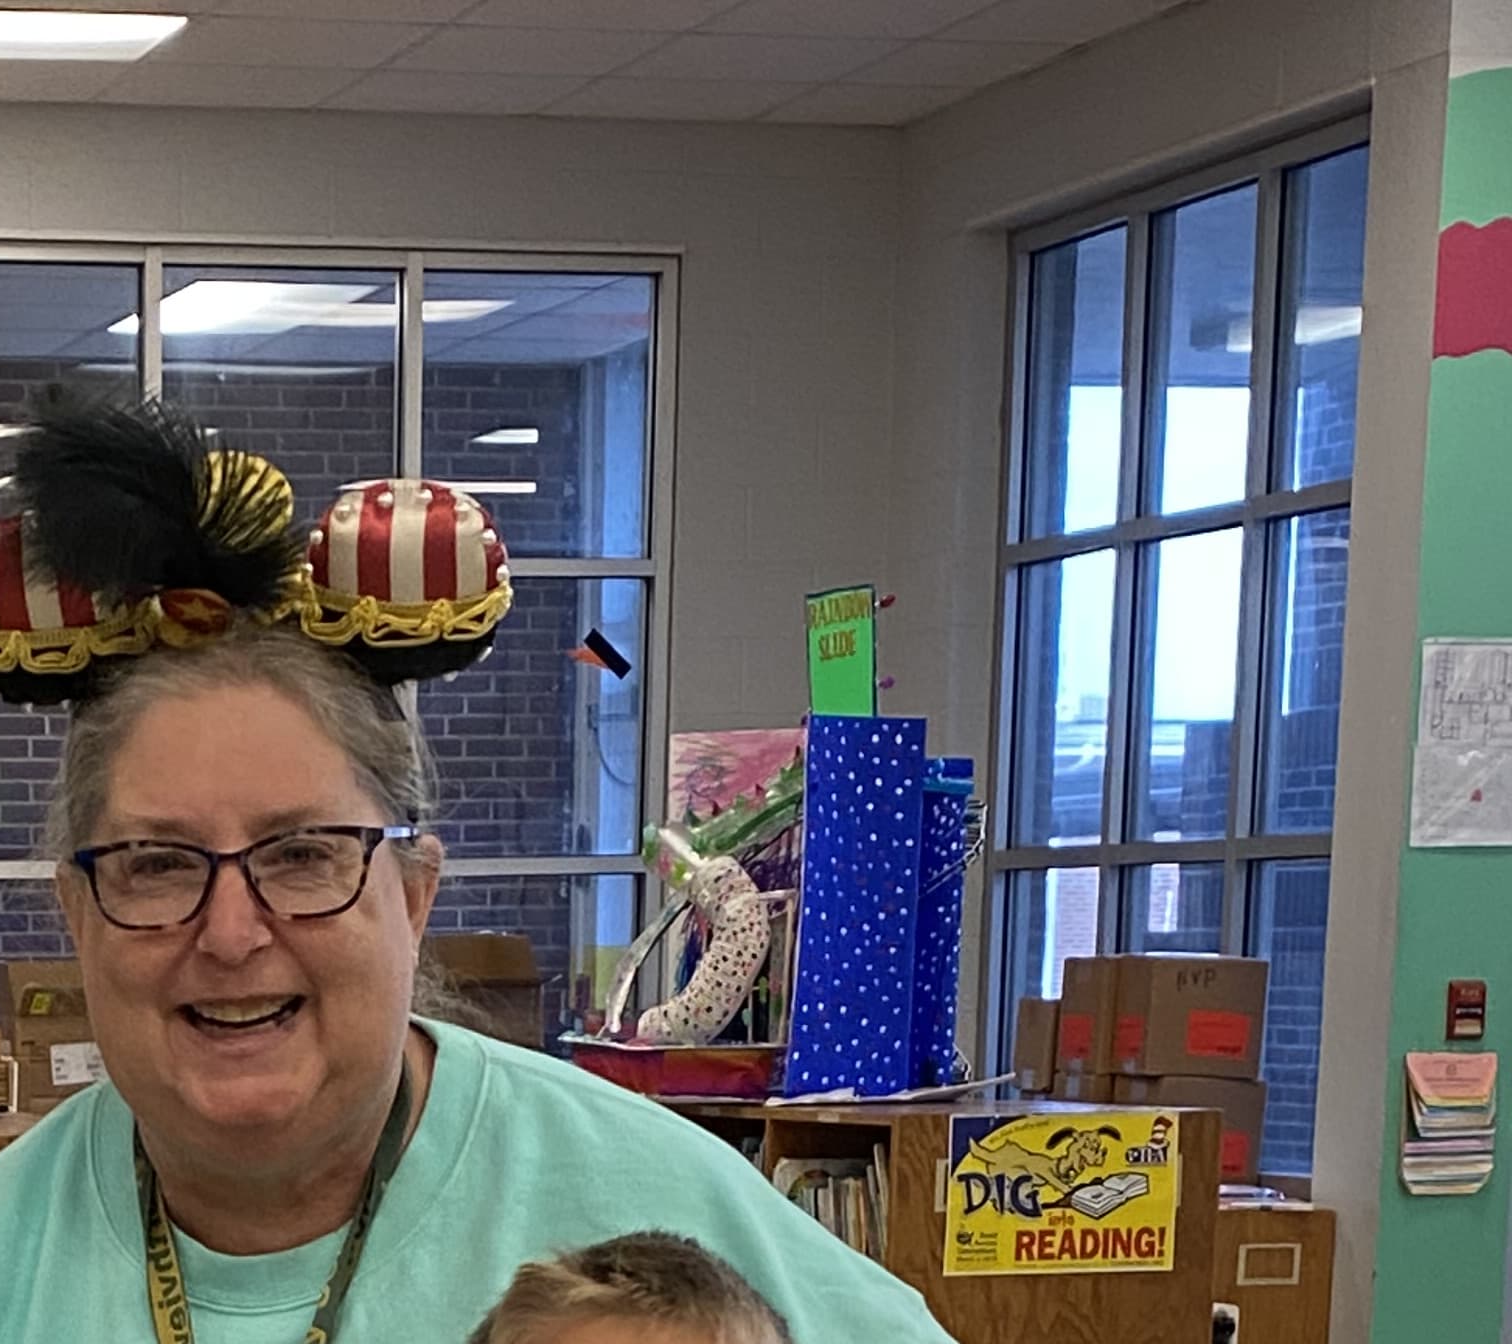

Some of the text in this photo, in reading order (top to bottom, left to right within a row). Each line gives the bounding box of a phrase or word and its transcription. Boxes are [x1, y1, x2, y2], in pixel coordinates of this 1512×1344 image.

[819, 629, 856, 662] SLIDE
[957, 1172, 1042, 1218] DIG
[1015, 1227, 1167, 1261] READING!
